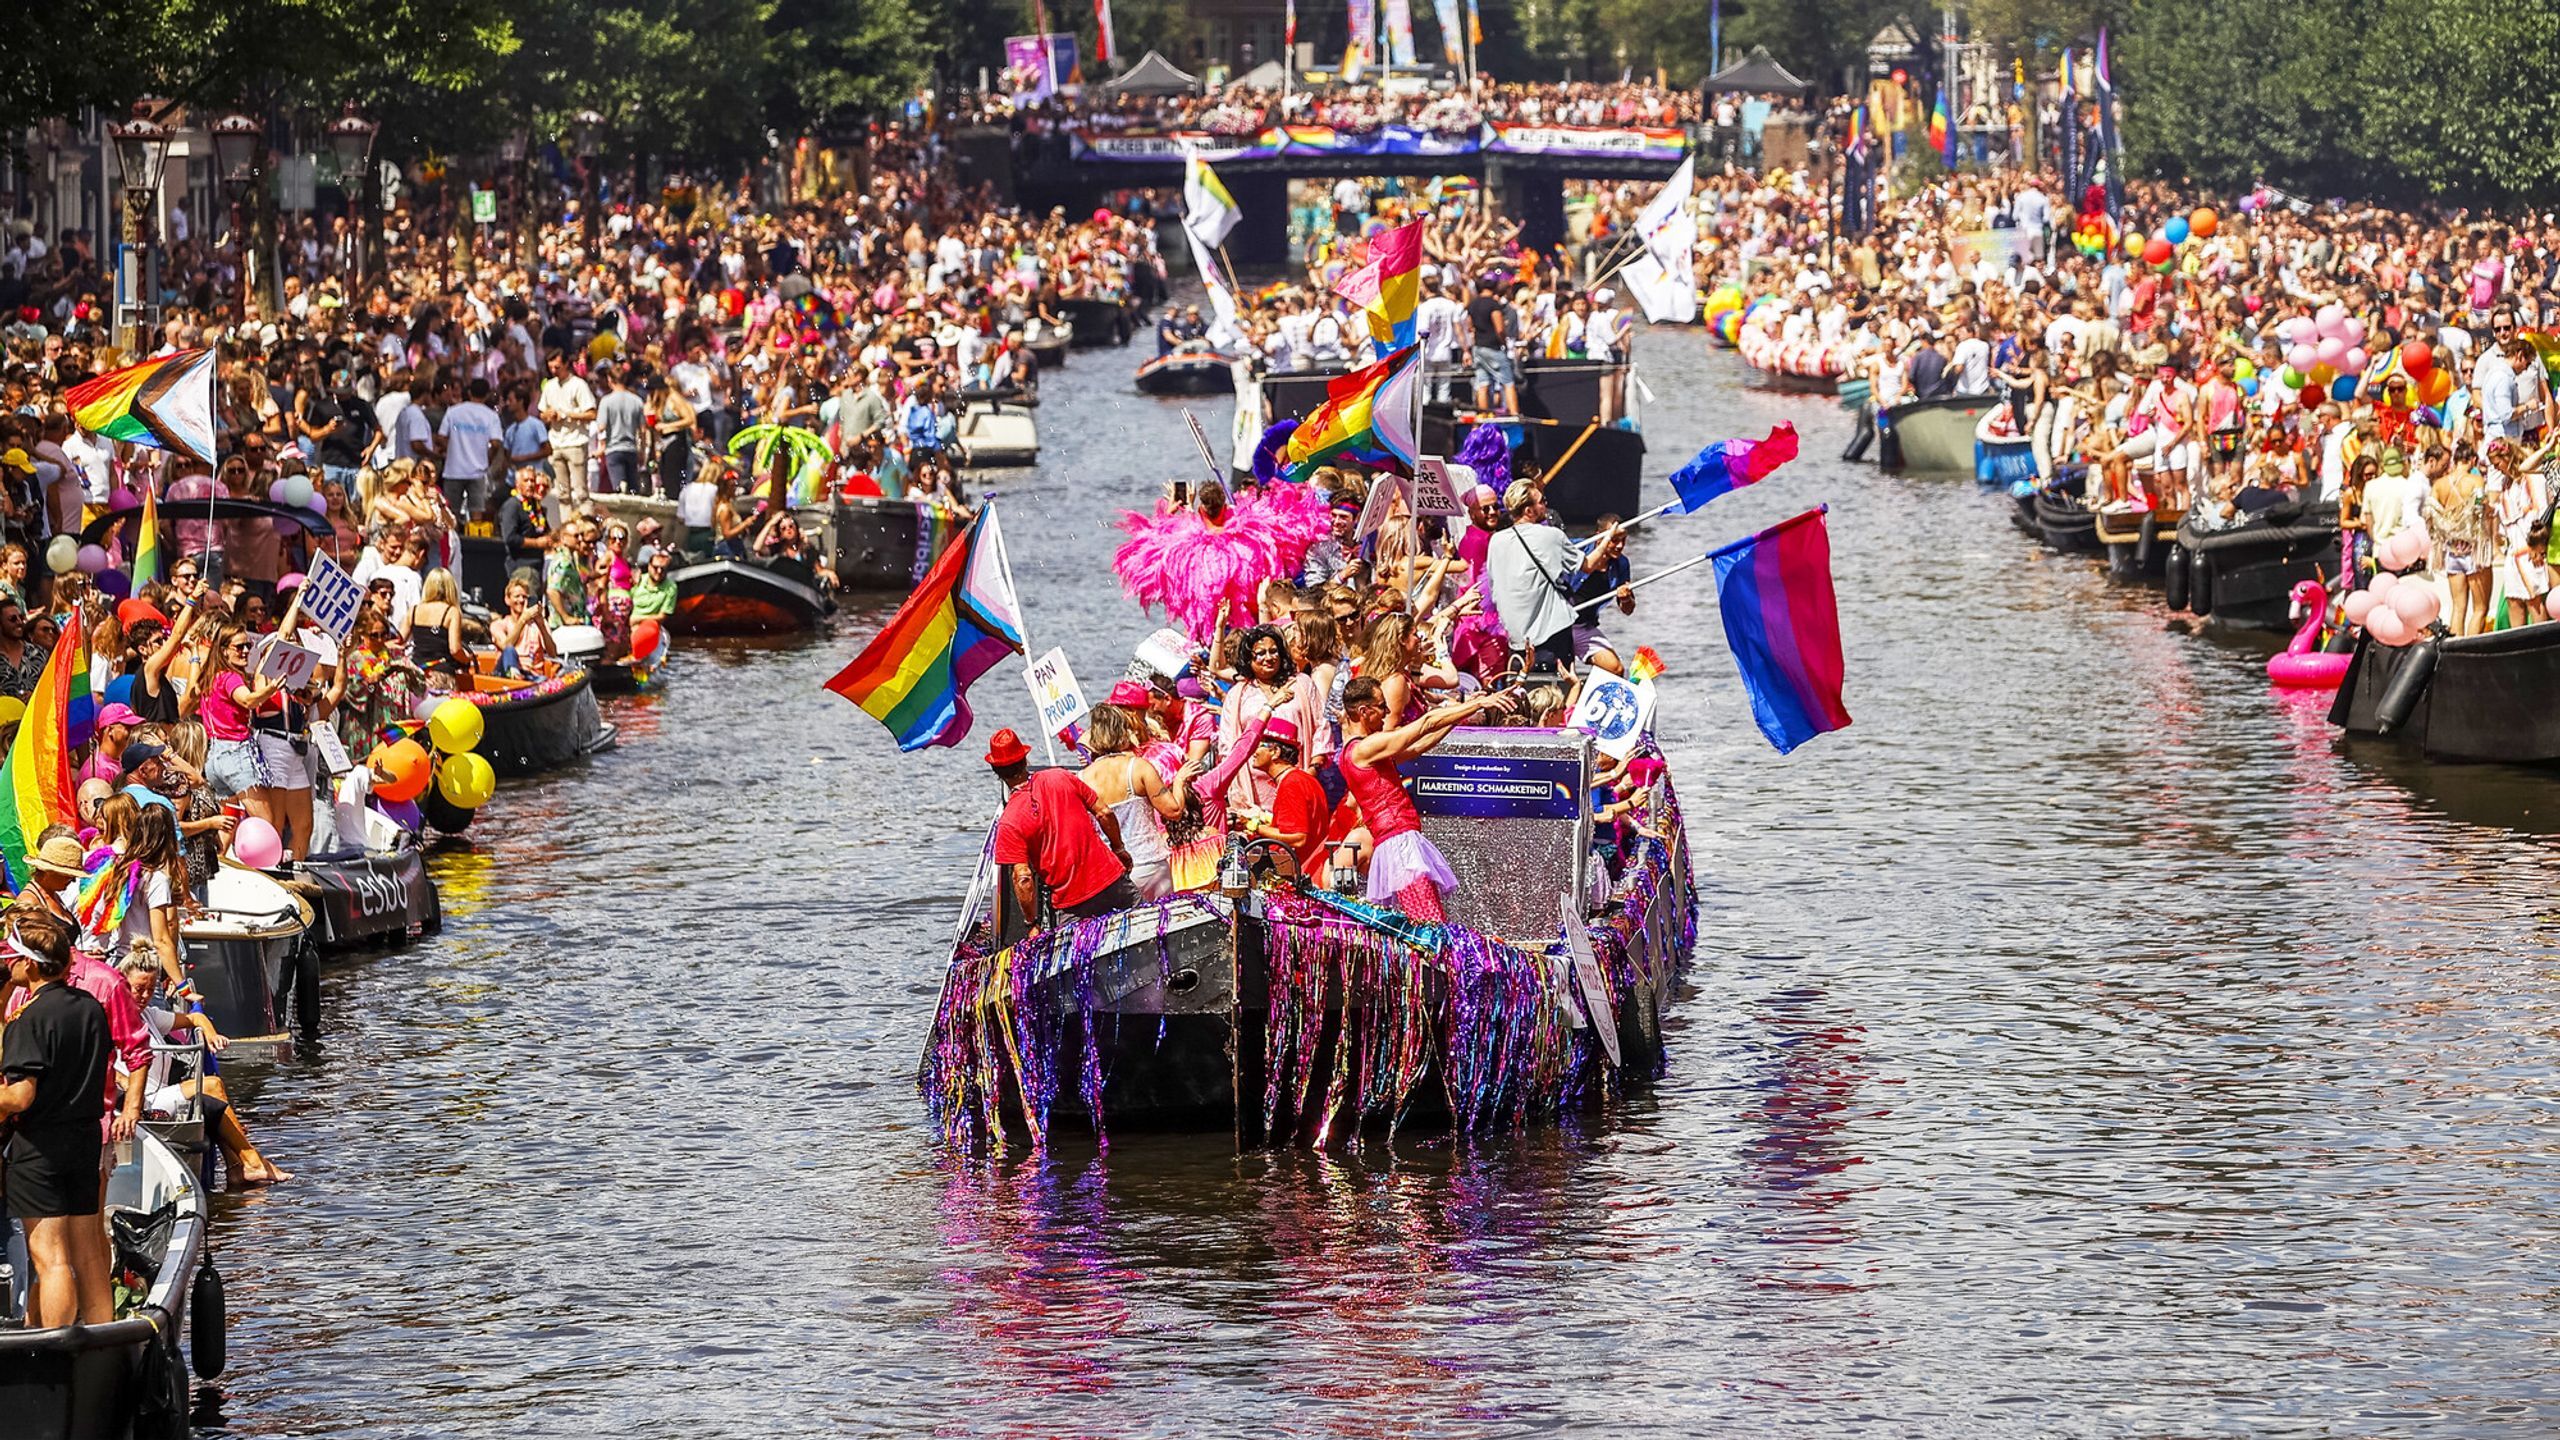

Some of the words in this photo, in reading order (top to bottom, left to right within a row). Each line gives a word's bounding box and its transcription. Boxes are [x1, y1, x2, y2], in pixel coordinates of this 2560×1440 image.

[303, 582, 353, 640] OUT!
[277, 650, 307, 676] 10
[1034, 660, 1057, 689] PAN
[1044, 693, 1077, 727] PROUD
[1421, 782, 1475, 793] MARKETING
[1477, 783, 1548, 795] SCHMARKETING
